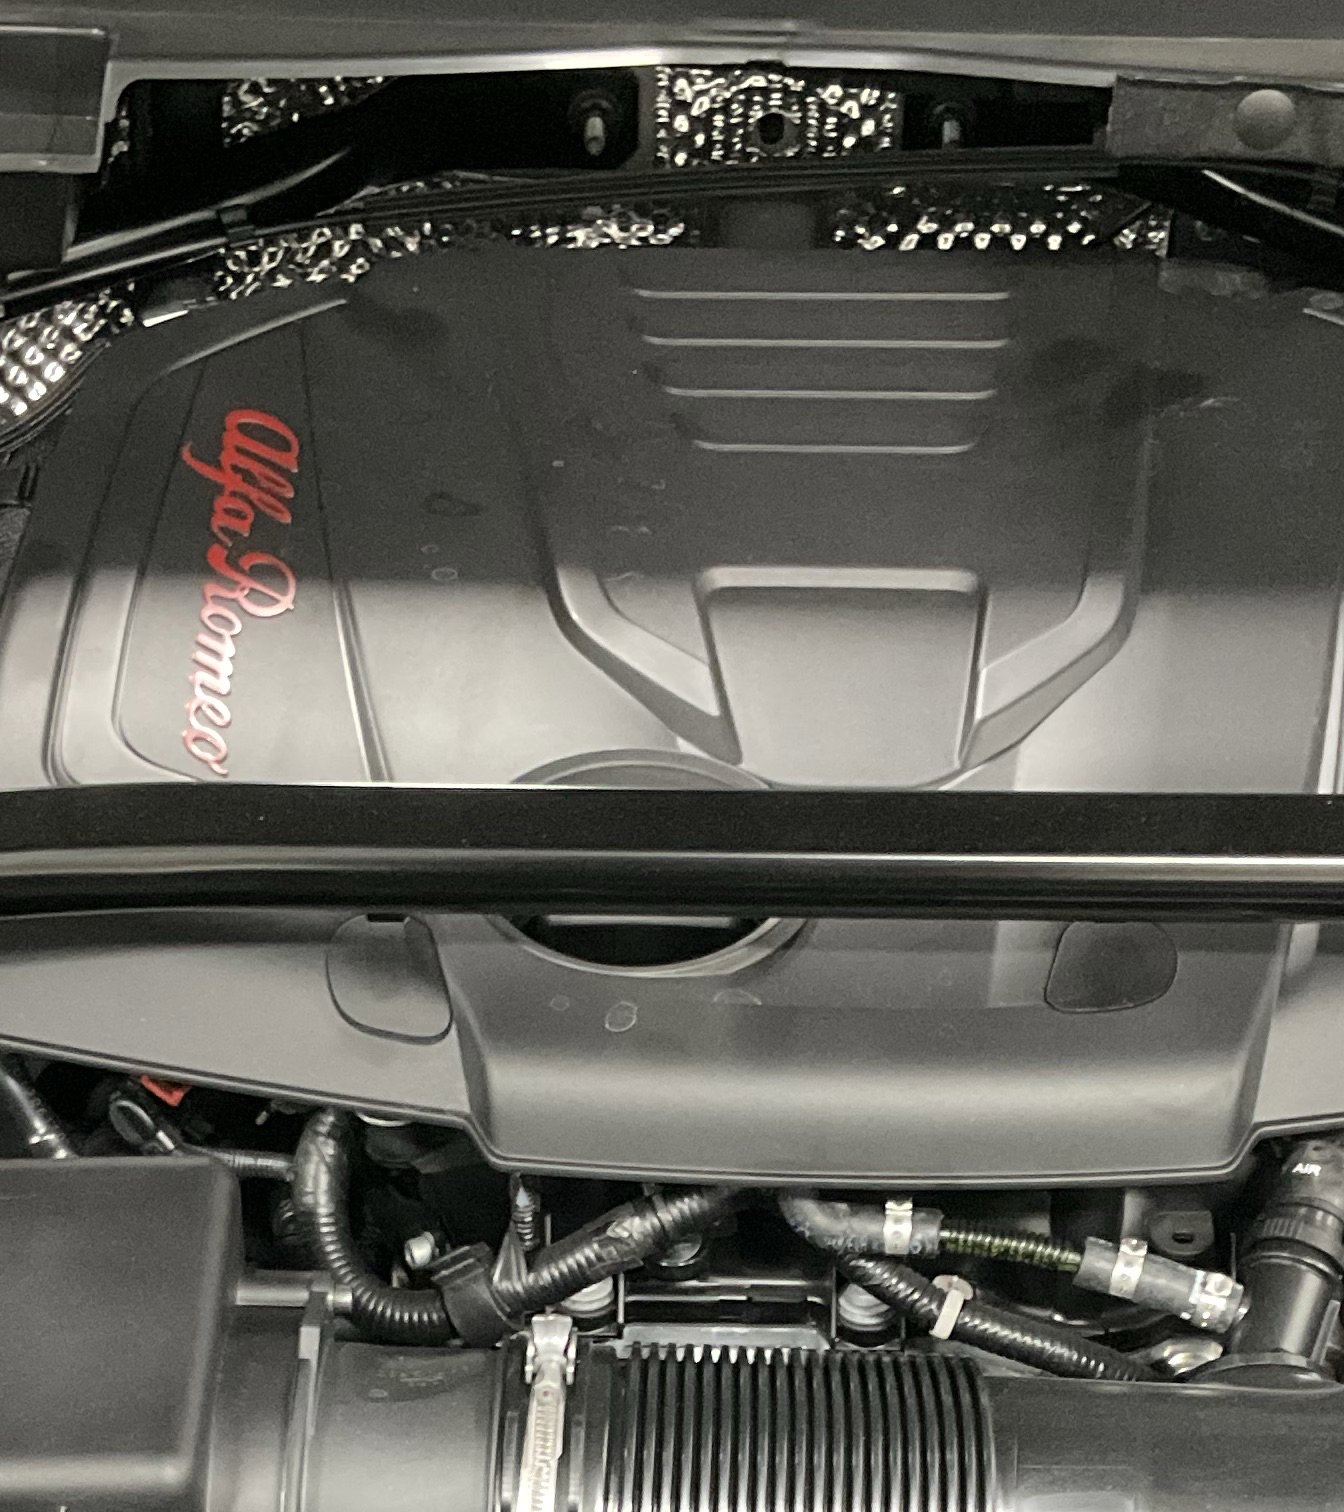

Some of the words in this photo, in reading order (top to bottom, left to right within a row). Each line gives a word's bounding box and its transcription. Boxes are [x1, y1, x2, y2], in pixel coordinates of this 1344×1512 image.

[181, 408, 300, 547] Alfa
[181, 542, 297, 777] Romeo
[1291, 1162, 1322, 1177] AIR
